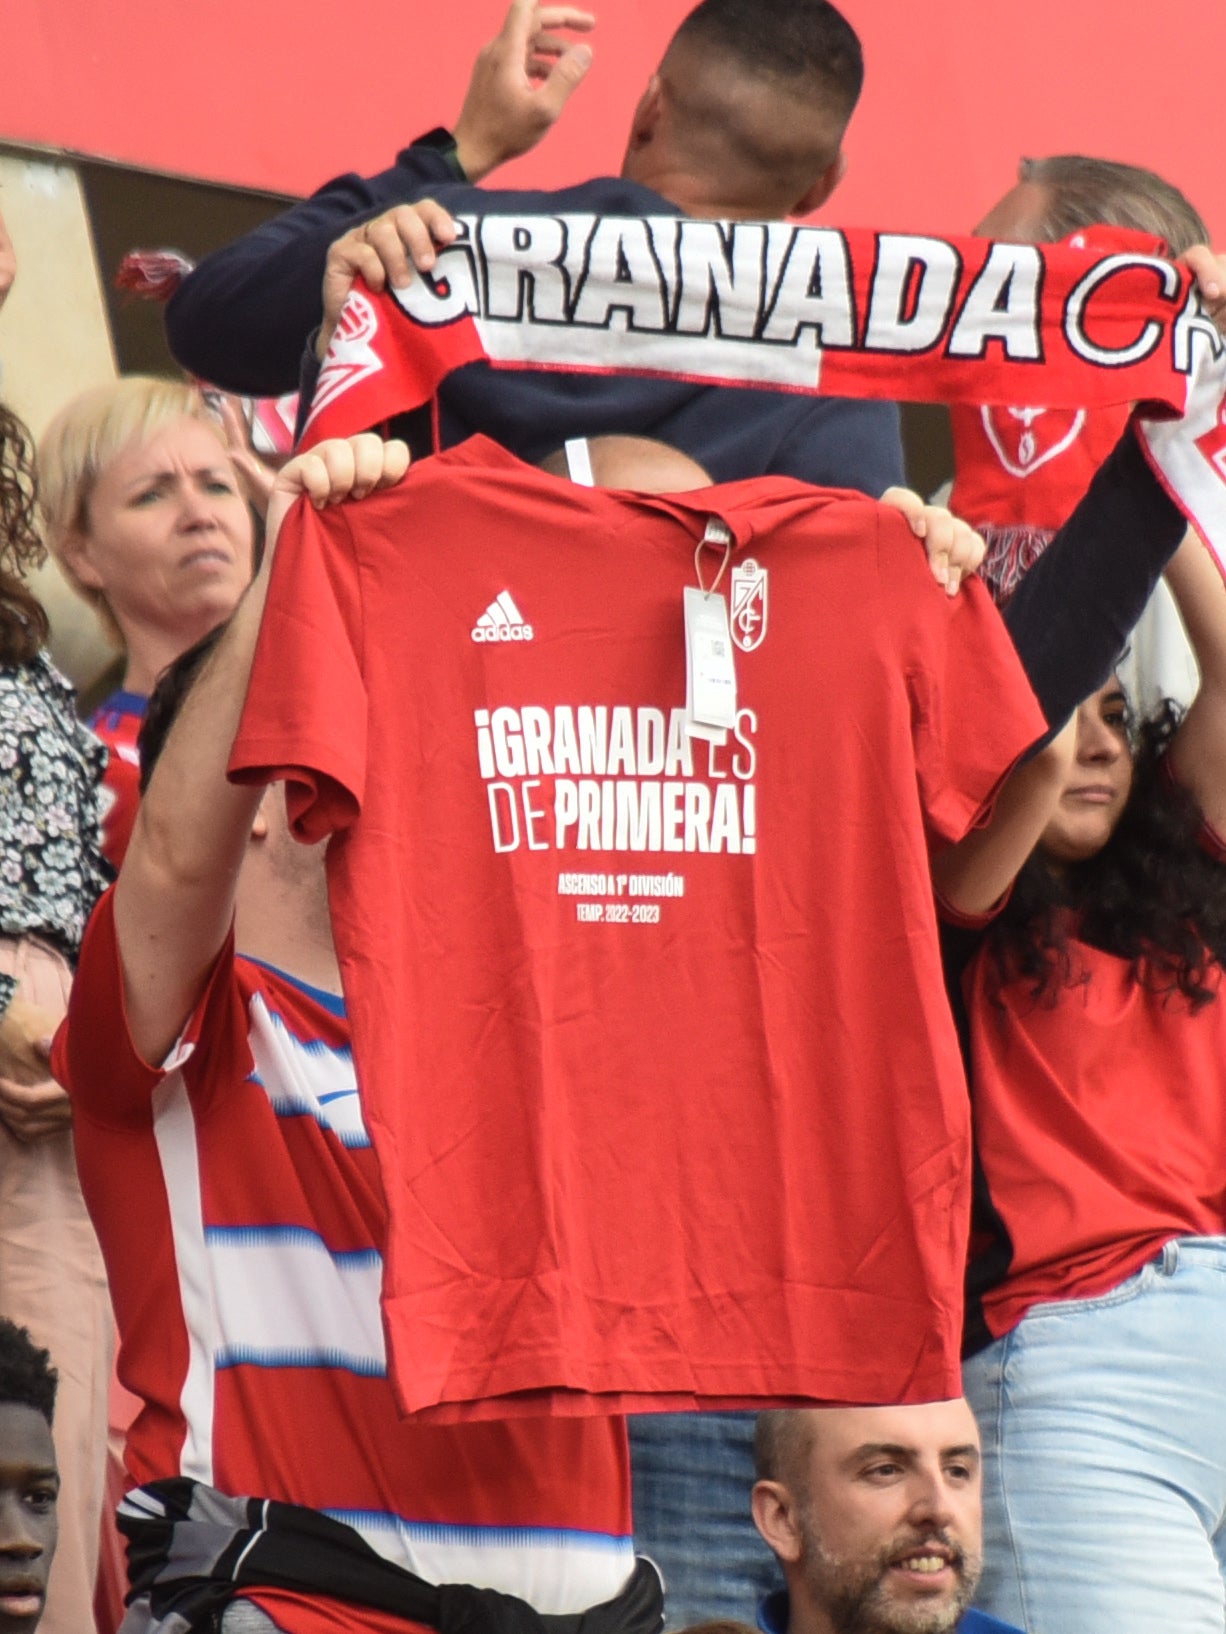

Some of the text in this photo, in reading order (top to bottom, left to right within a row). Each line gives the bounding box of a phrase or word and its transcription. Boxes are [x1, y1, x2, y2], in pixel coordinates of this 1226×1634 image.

[390, 213, 1046, 365] GRANADA
[471, 624, 534, 643] adidas
[474, 705, 694, 779] ¡GRANADA
[487, 778, 756, 855] DE PRIMERA!
[557, 872, 607, 896] ASCENSO
[607, 874, 616, 896] A
[628, 871, 685, 897] DIVISIÓN
[577, 903, 660, 924] TEMP. 2022-2023
